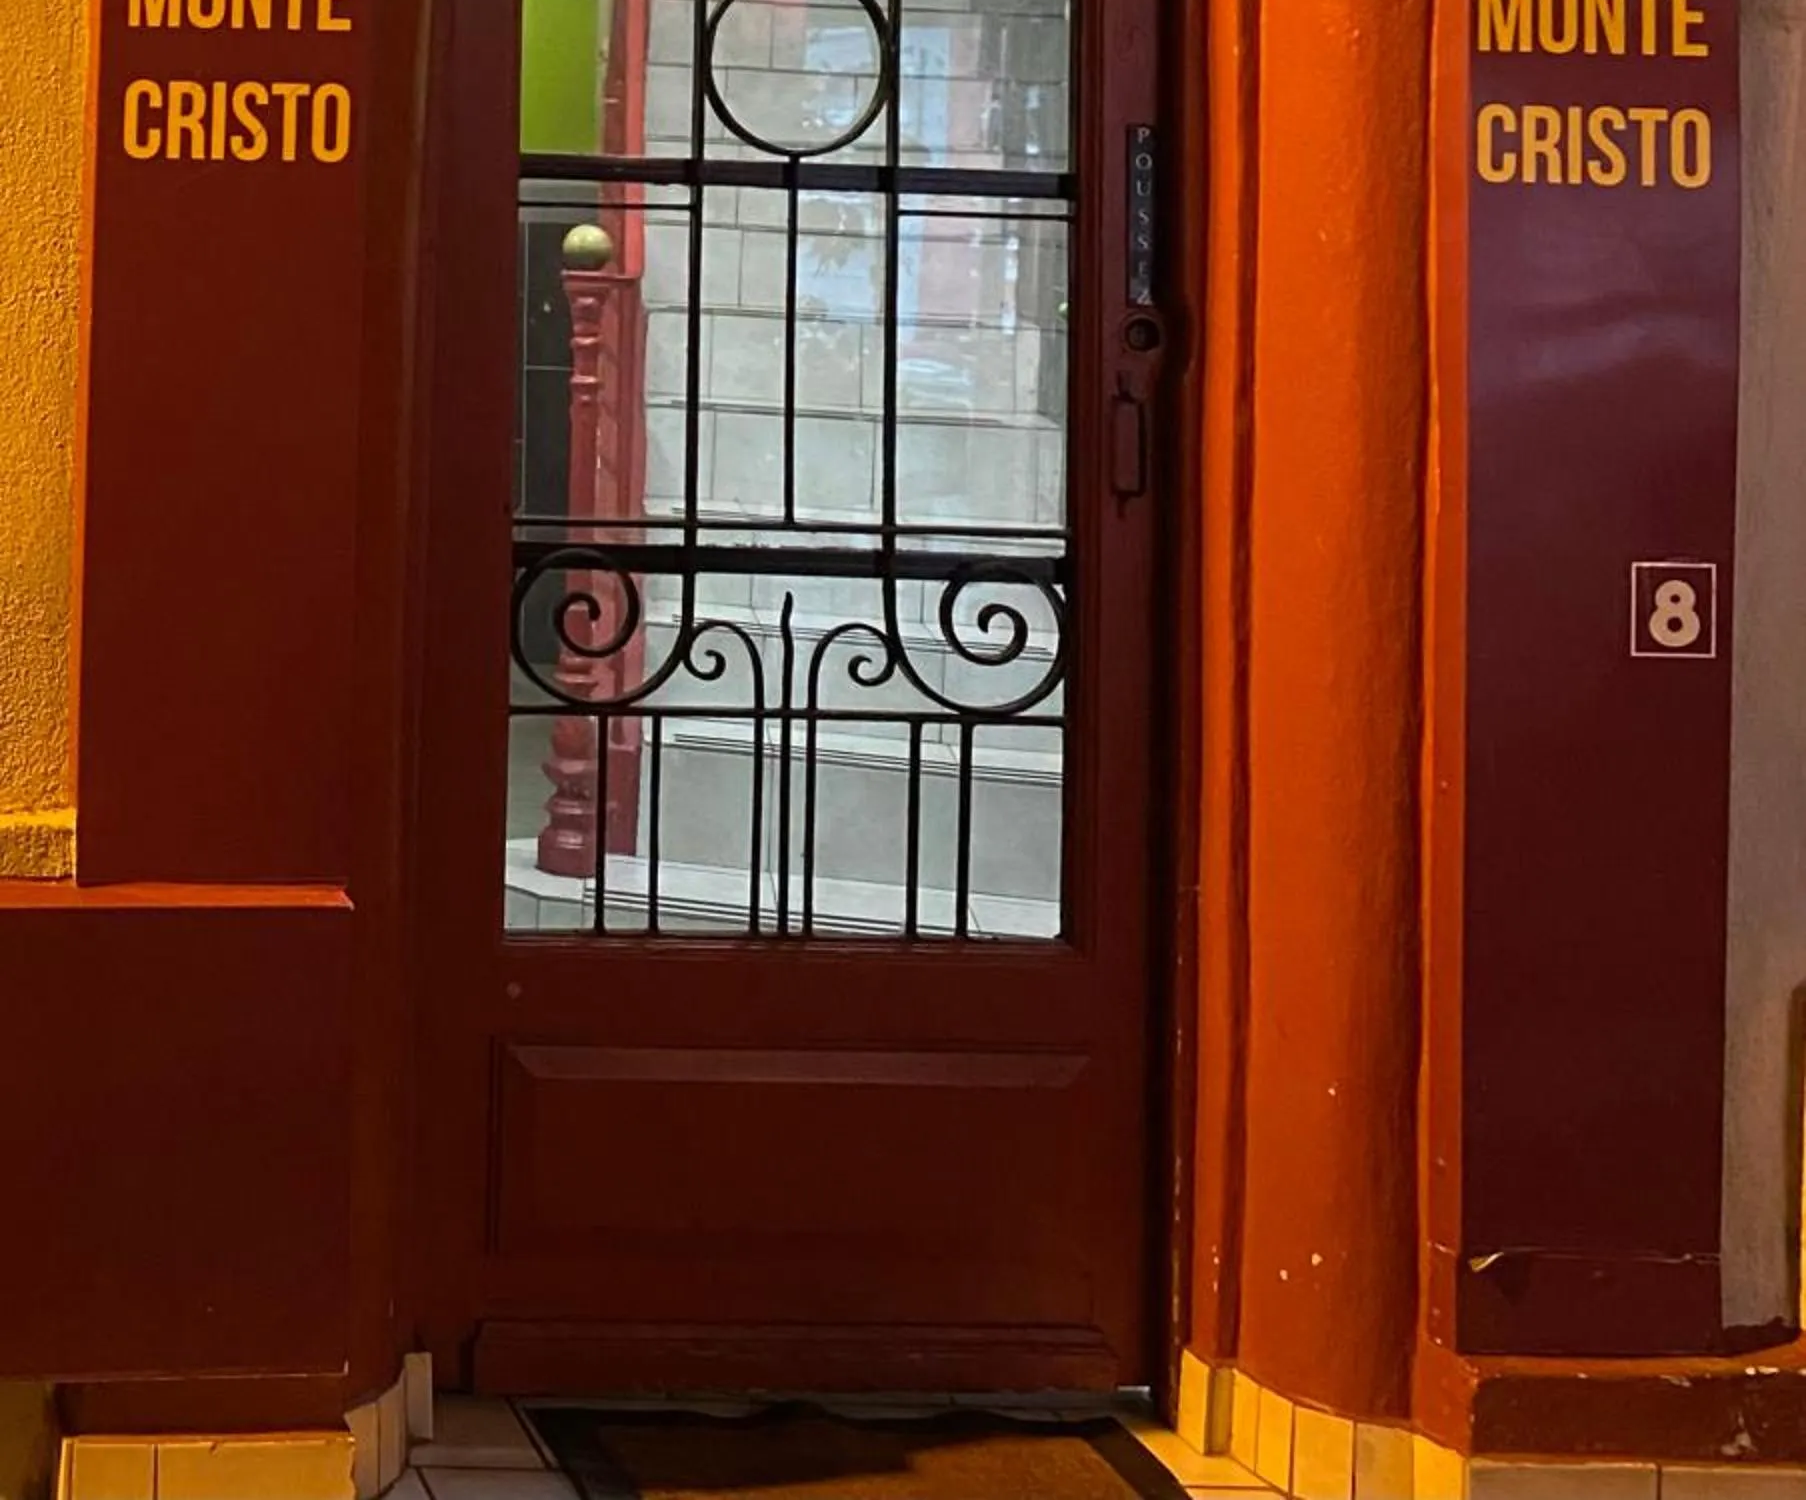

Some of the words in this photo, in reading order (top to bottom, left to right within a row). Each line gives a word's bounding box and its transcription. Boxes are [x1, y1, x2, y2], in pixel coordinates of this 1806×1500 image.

[123, 79, 352, 164] CRISTO
[1476, 103, 1712, 189] CRISTO
[1649, 579, 1701, 647] 8
